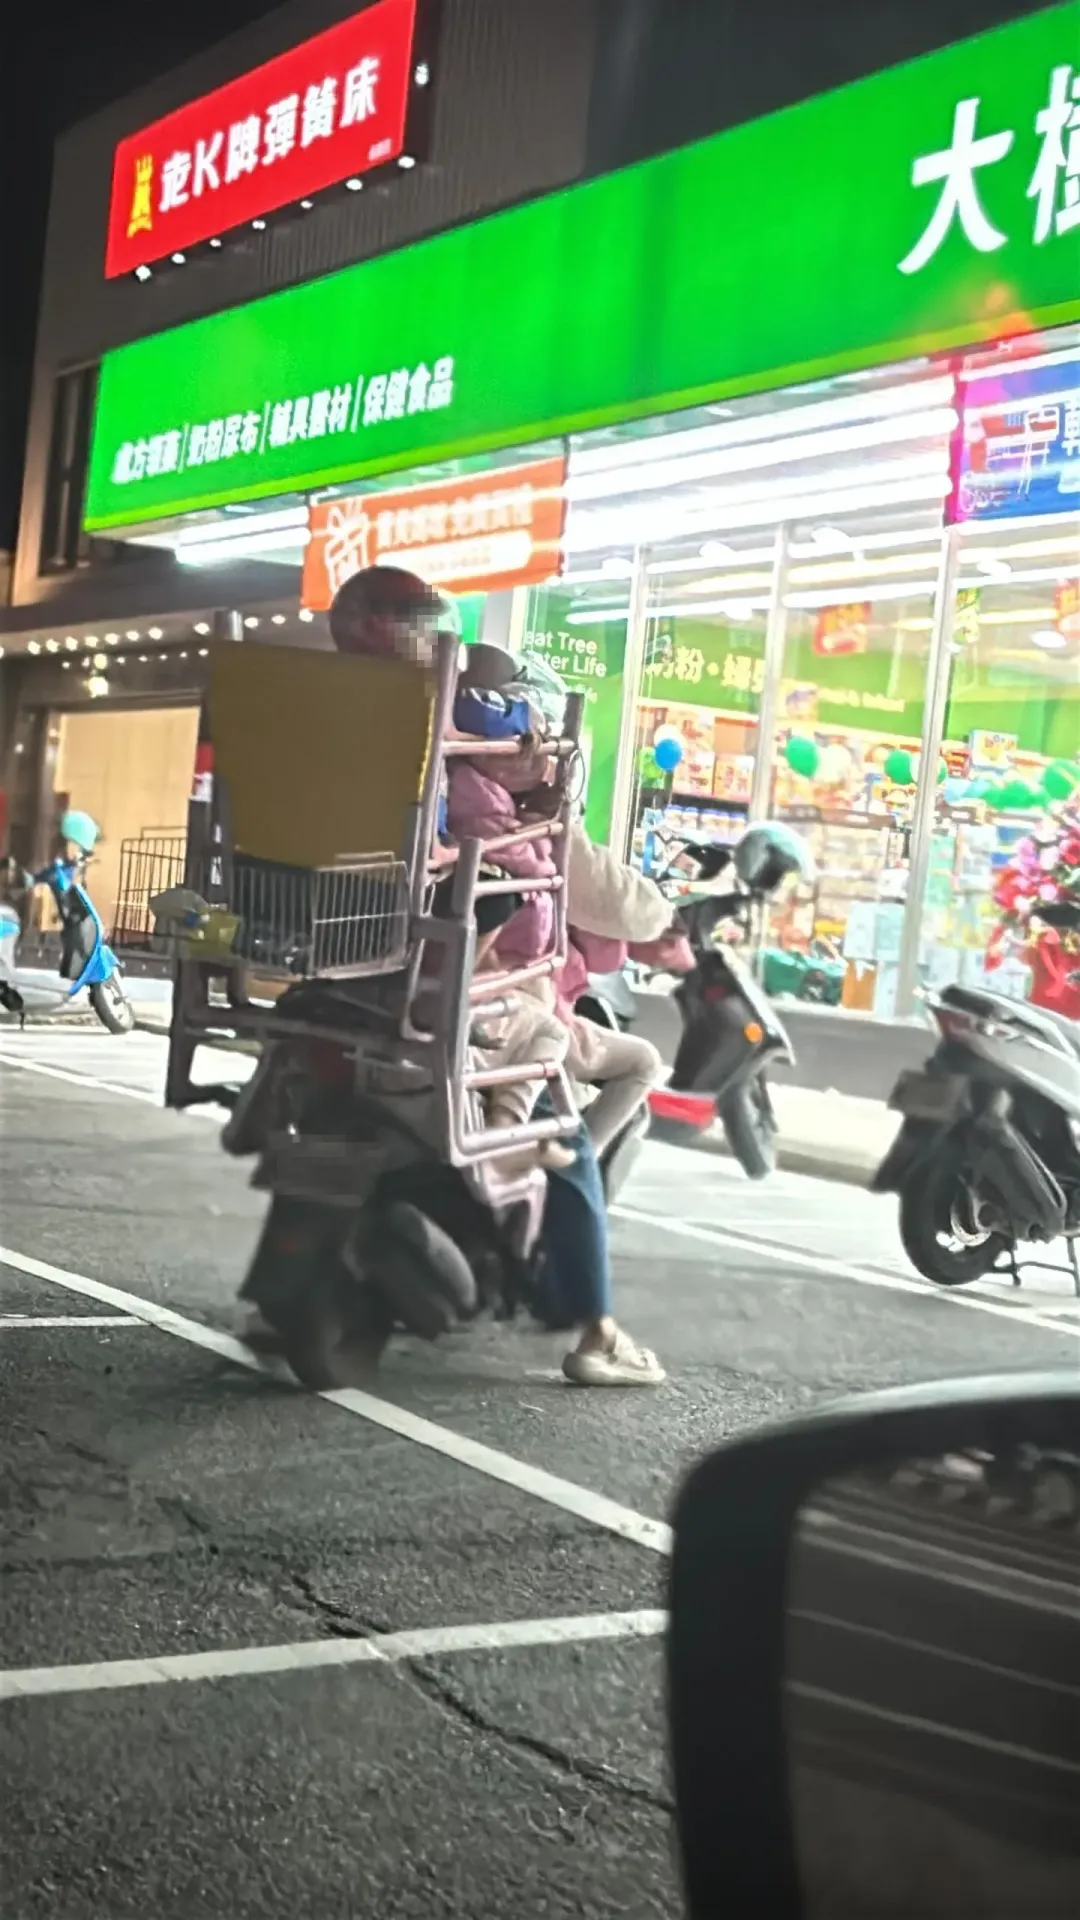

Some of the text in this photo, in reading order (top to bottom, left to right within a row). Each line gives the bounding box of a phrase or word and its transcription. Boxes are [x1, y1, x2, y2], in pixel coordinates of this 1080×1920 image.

[159, 55, 380, 212] 老K牌彈簧床
[363, 356, 454, 425] 保健食品
[557, 632, 597, 655] Tree
[573, 654, 607, 678] Life
